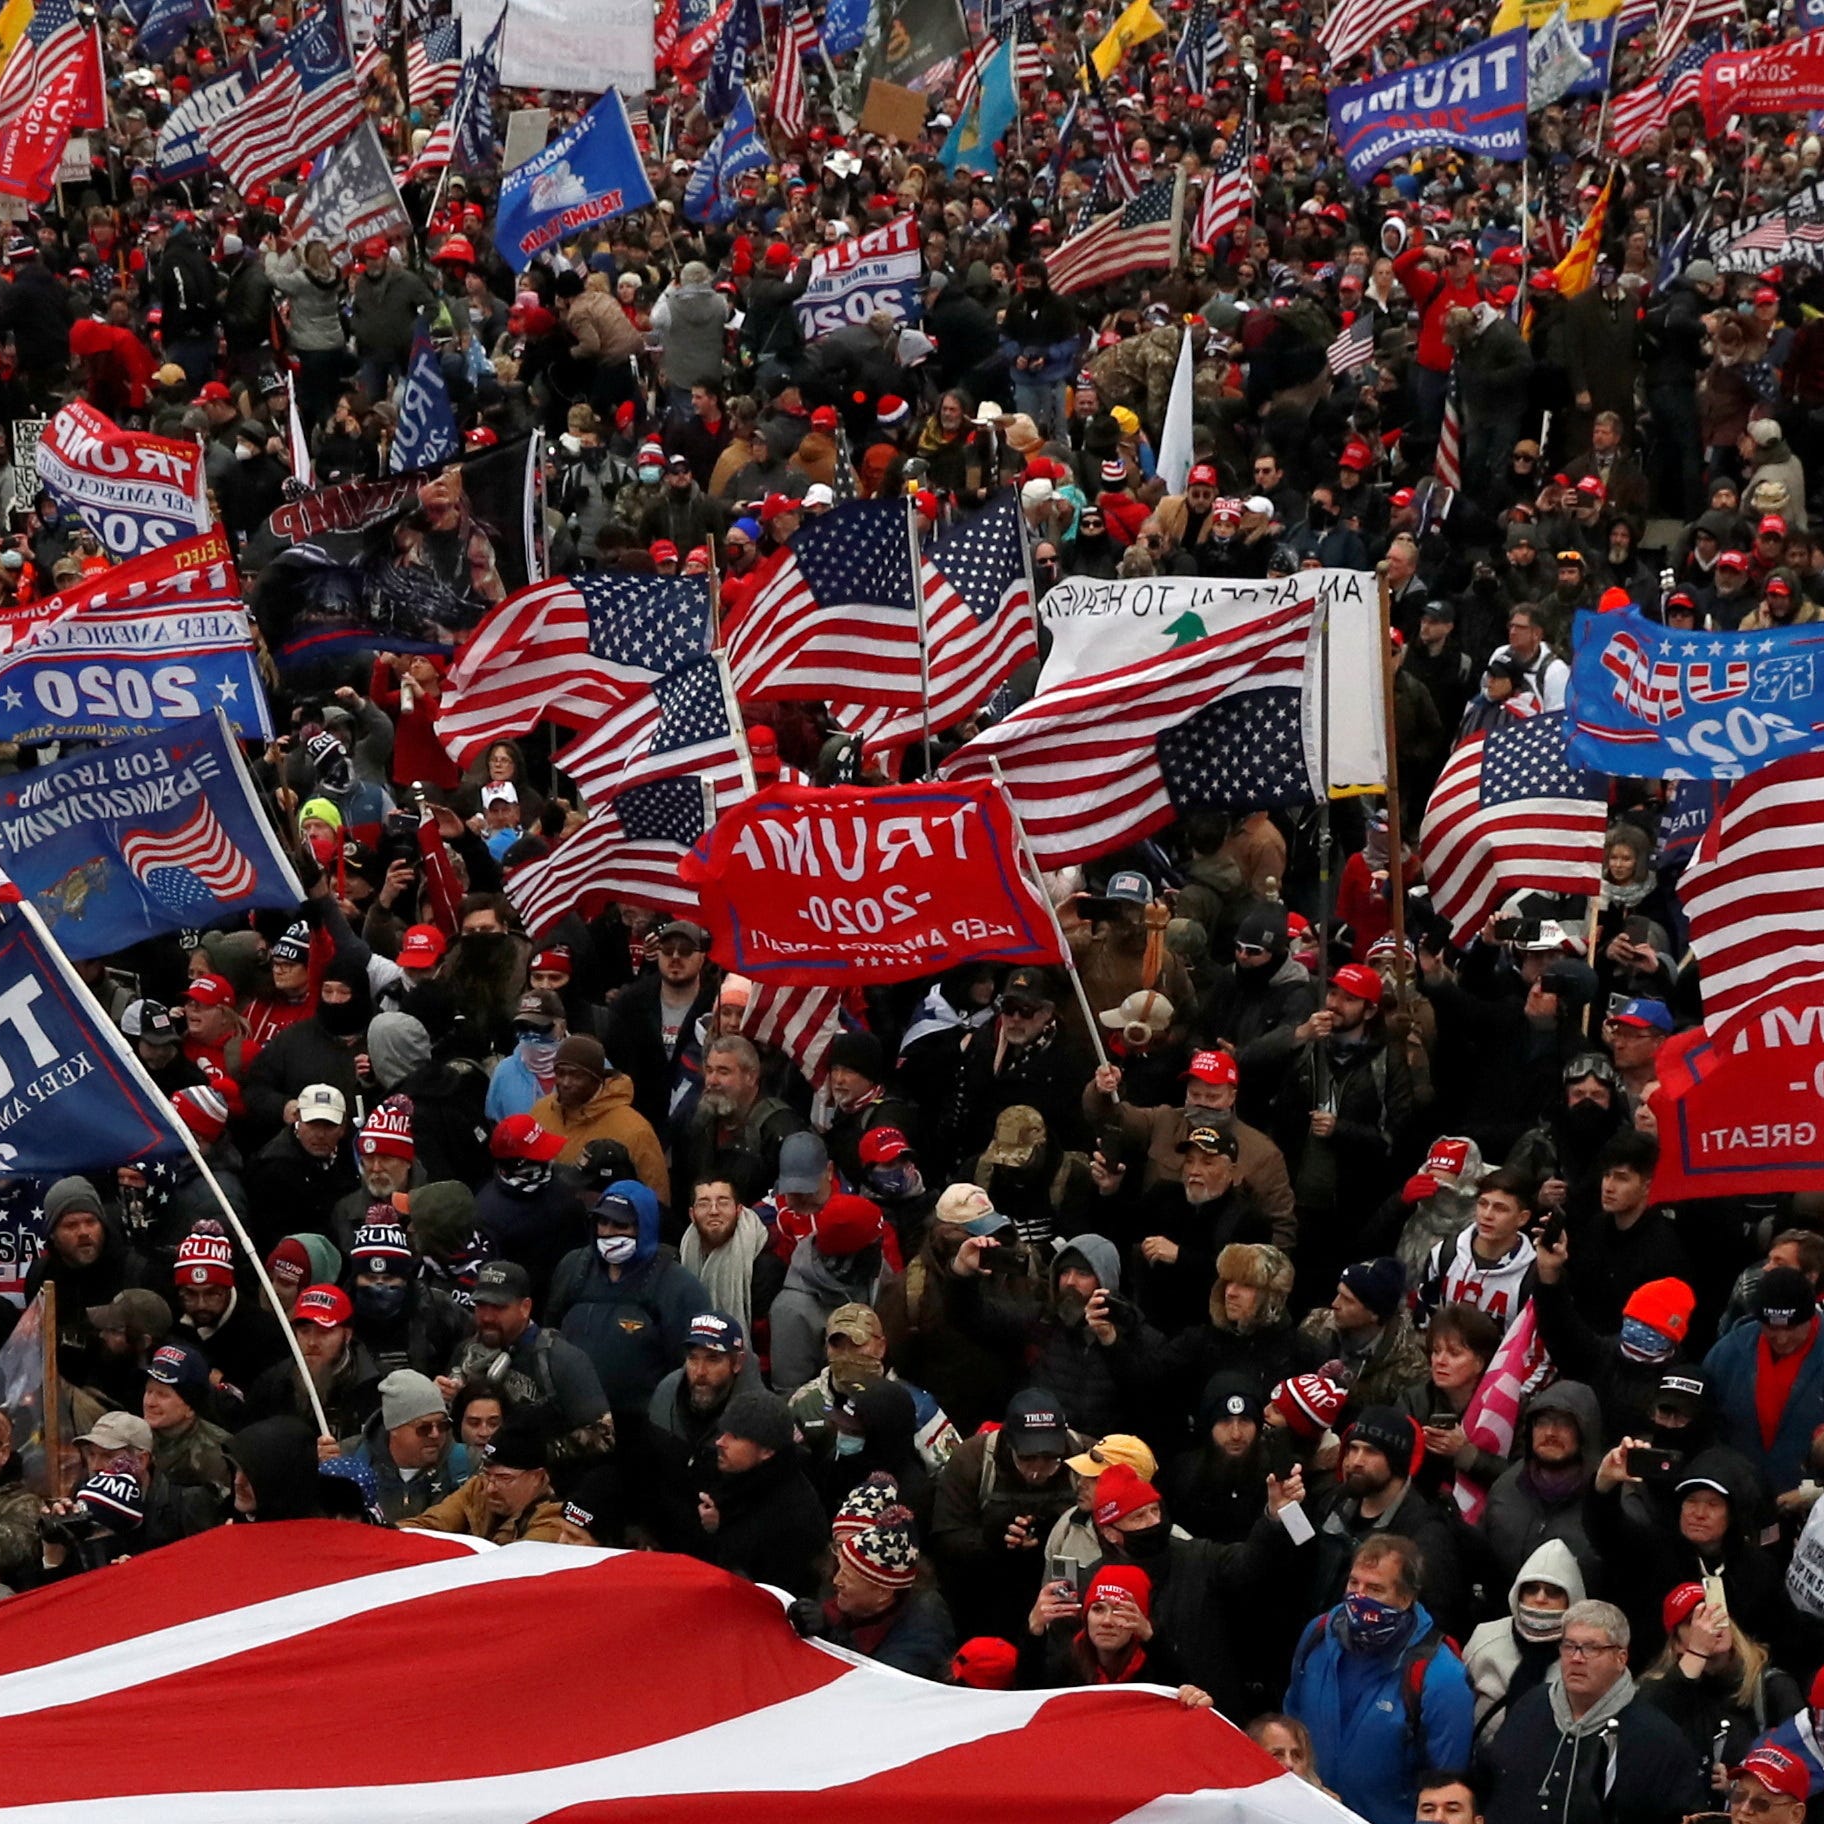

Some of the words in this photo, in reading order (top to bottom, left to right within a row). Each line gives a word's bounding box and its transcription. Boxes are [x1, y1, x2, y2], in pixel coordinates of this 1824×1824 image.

[119, 749, 170, 779] FOR
[18, 756, 110, 808] TRUMP
[3, 772, 203, 855] PENNSYLVANIA
[179, 1242, 233, 1262] RUM
[690, 1316, 728, 1331] TRUMP
[1025, 1413, 1057, 1423] TRUMP
[86, 1474, 141, 1500] UMP
